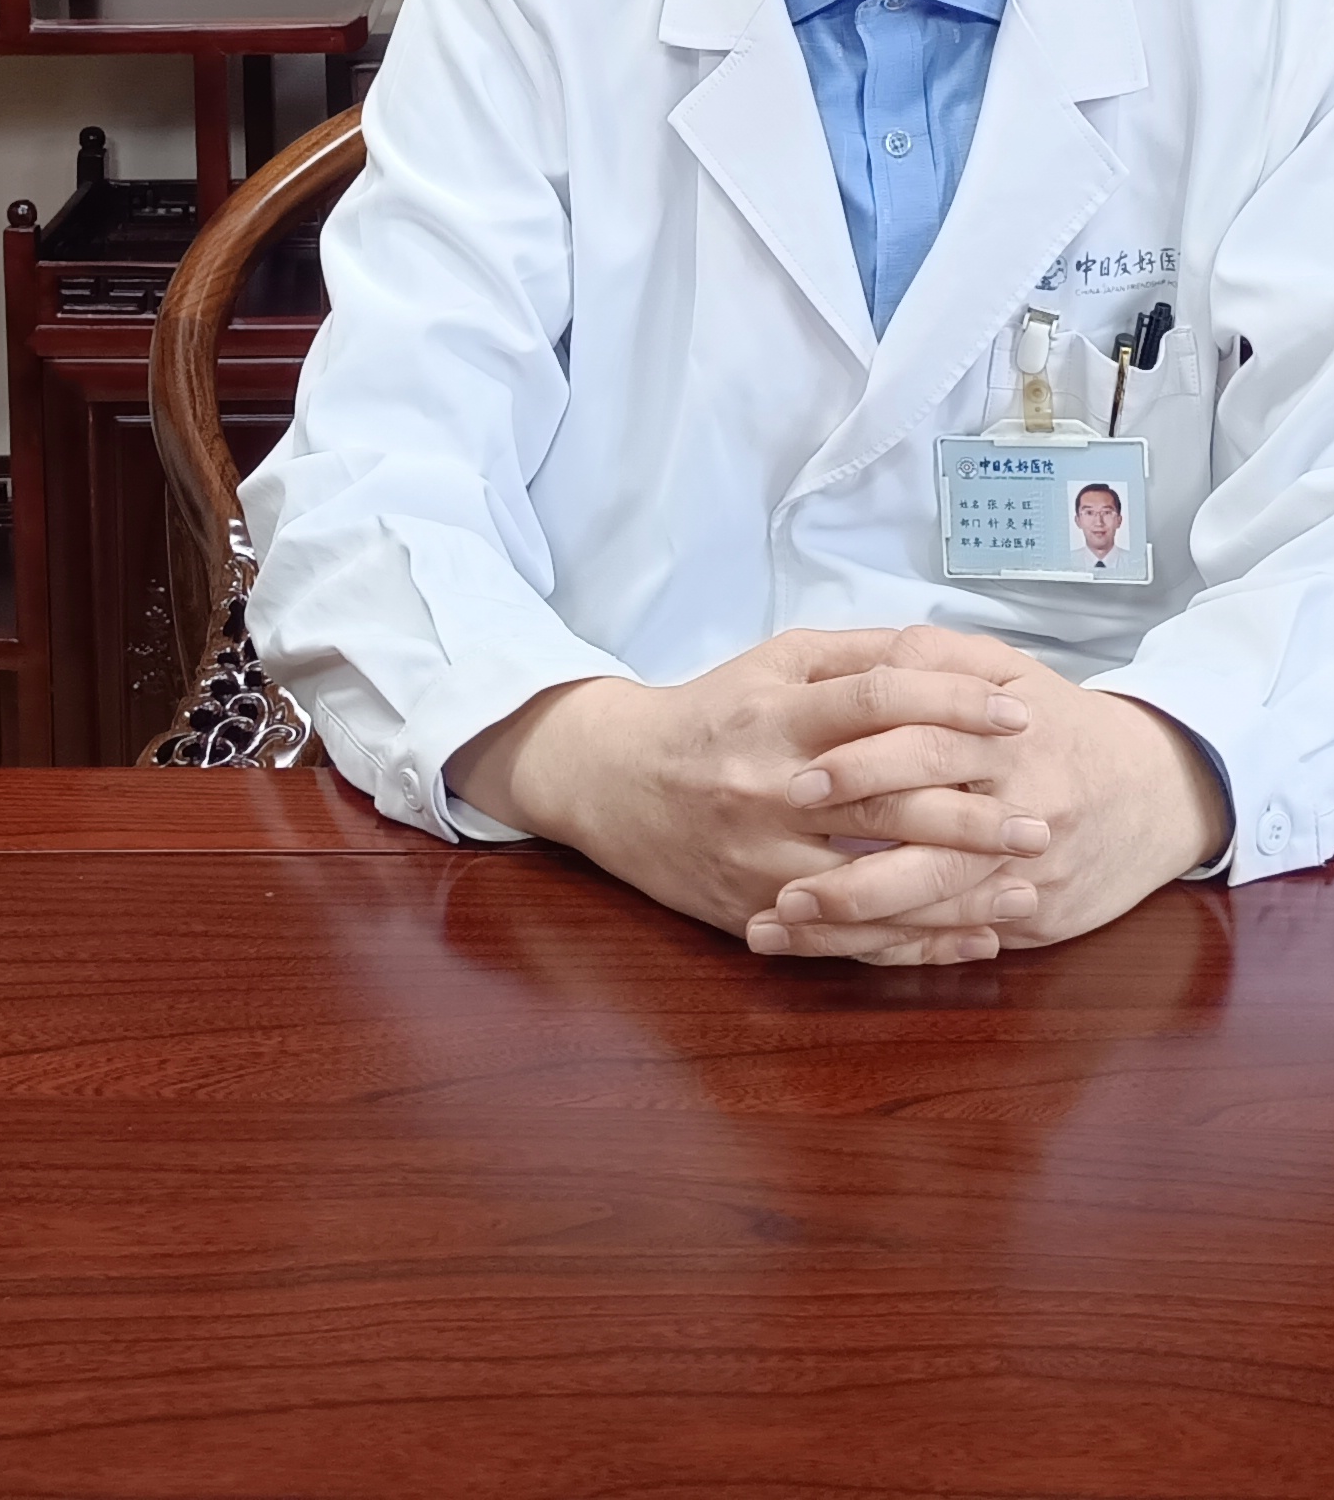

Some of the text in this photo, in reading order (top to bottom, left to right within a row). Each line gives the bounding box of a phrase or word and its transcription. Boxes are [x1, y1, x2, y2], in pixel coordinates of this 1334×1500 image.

[1075, 247, 1180, 286] 中日友好医
[978, 456, 1055, 475] 中日友好医院
[958, 499, 980, 510] 姓名
[959, 517, 1034, 530] 部门 针灸科
[960, 536, 1036, 549] 职务 主治医师
